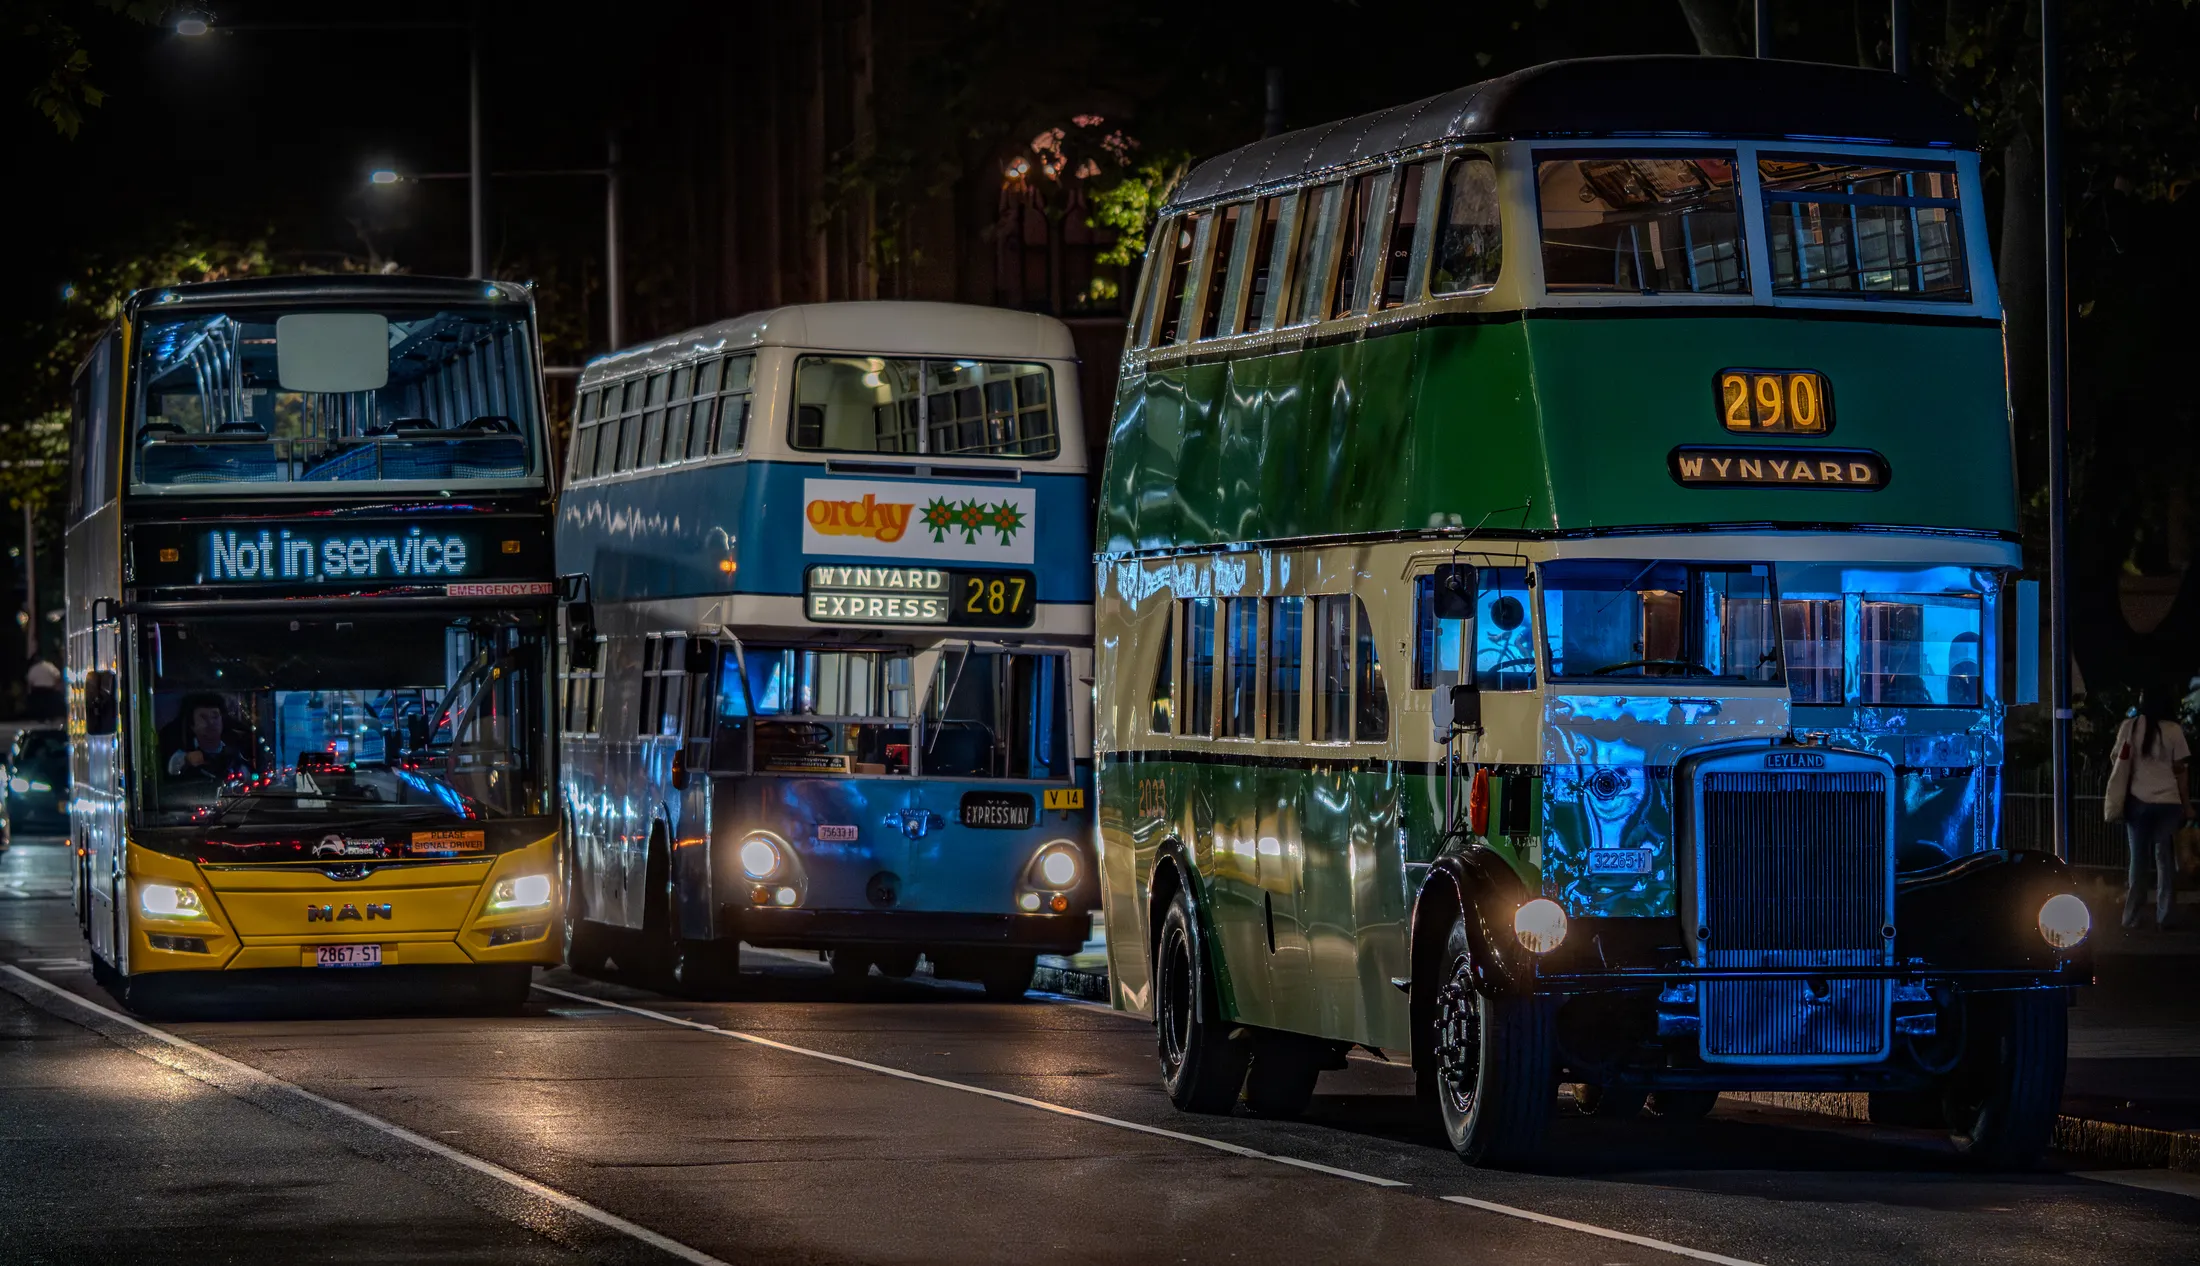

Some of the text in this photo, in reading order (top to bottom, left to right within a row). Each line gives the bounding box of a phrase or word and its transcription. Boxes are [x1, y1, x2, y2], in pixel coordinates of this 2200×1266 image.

[1723, 375, 1817, 427] 290
[1679, 457, 1872, 482] WYNYARD
[211, 529, 466, 577] Not in service
[818, 567, 942, 589] WYNYARD
[449, 584, 527, 596] EMERGENCY
[967, 577, 1027, 615] 287
[1767, 753, 1824, 767] LEYLAND
[1050, 791, 1078, 806] V 14
[966, 805, 1029, 825] EXPRESSWAY
[346, 837, 385, 846] Transport
[431, 831, 466, 839] PLEASE
[347, 847, 374, 855] Buses
[414, 840, 483, 850] SIGNAL DRIVER
[307, 903, 392, 922] MAN
[320, 946, 379, 962] 2867-ST
